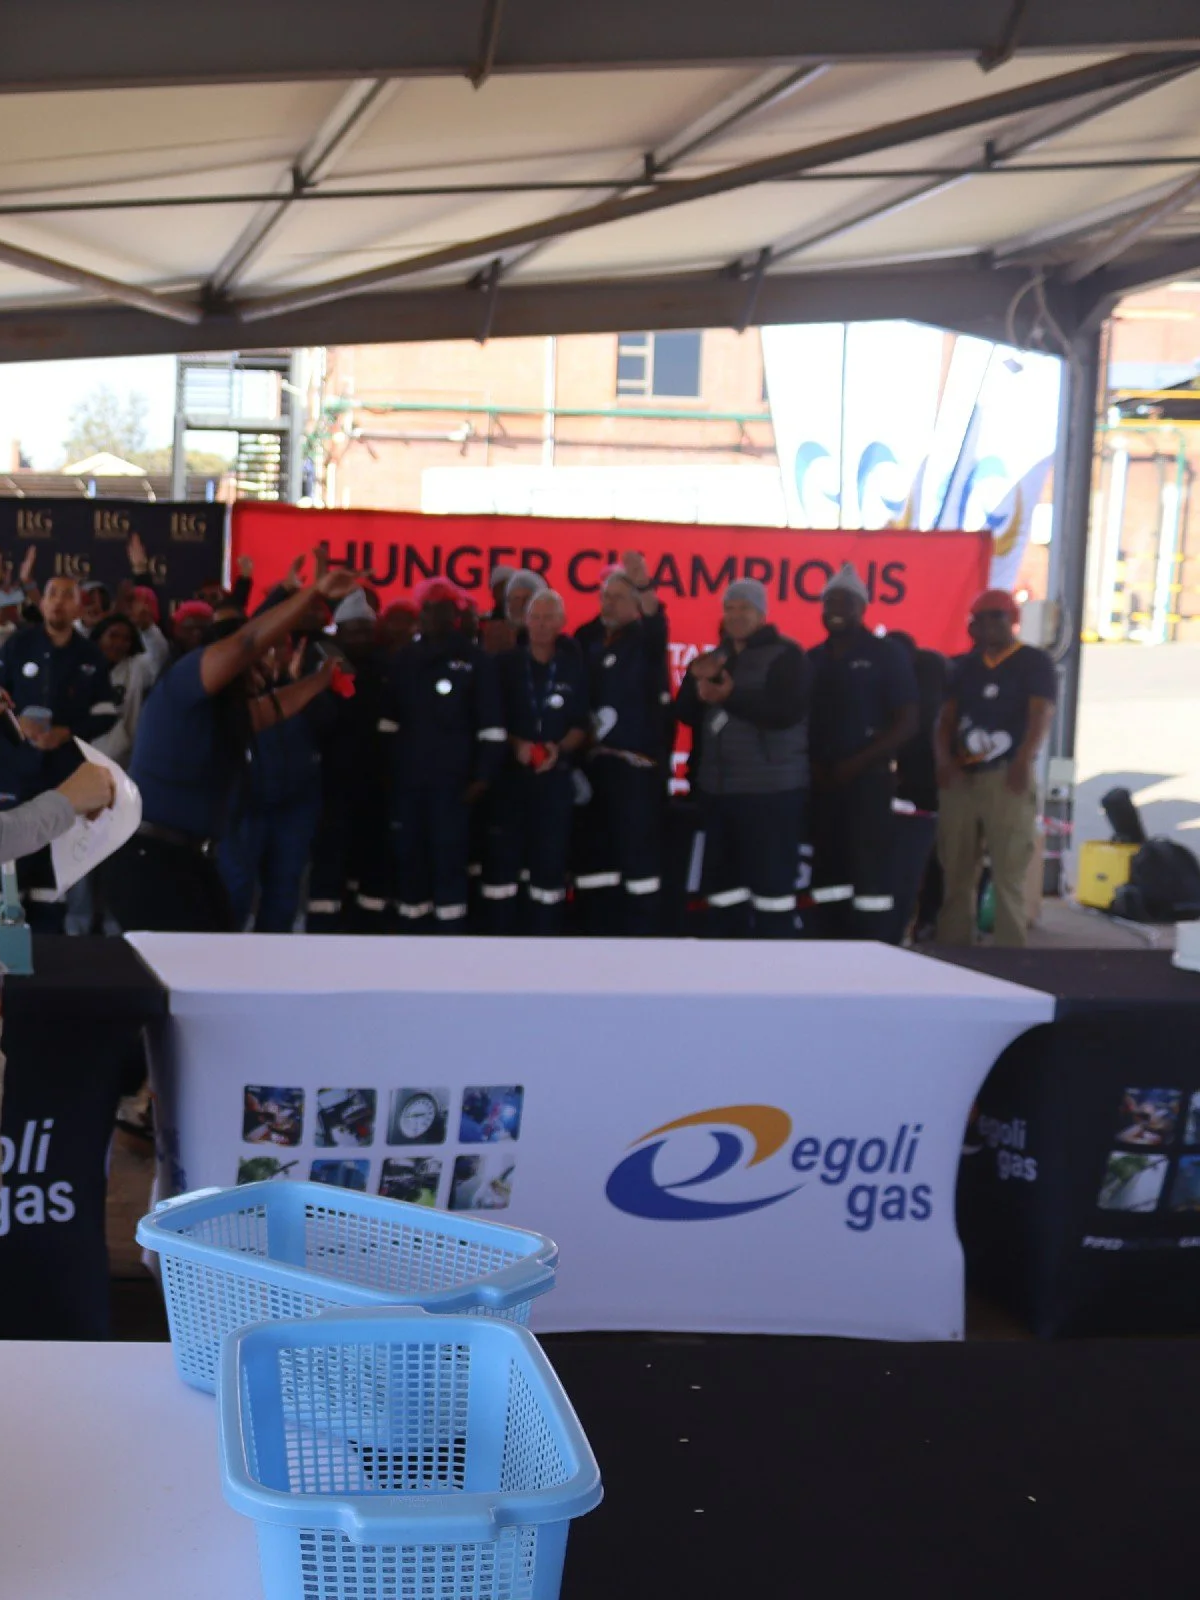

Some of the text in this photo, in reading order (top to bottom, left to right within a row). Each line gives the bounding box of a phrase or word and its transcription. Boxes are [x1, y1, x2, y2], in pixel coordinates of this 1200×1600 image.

[791, 1123, 924, 1185] egoli
[997, 1150, 1037, 1181] gas
[845, 1183, 933, 1232] gas
